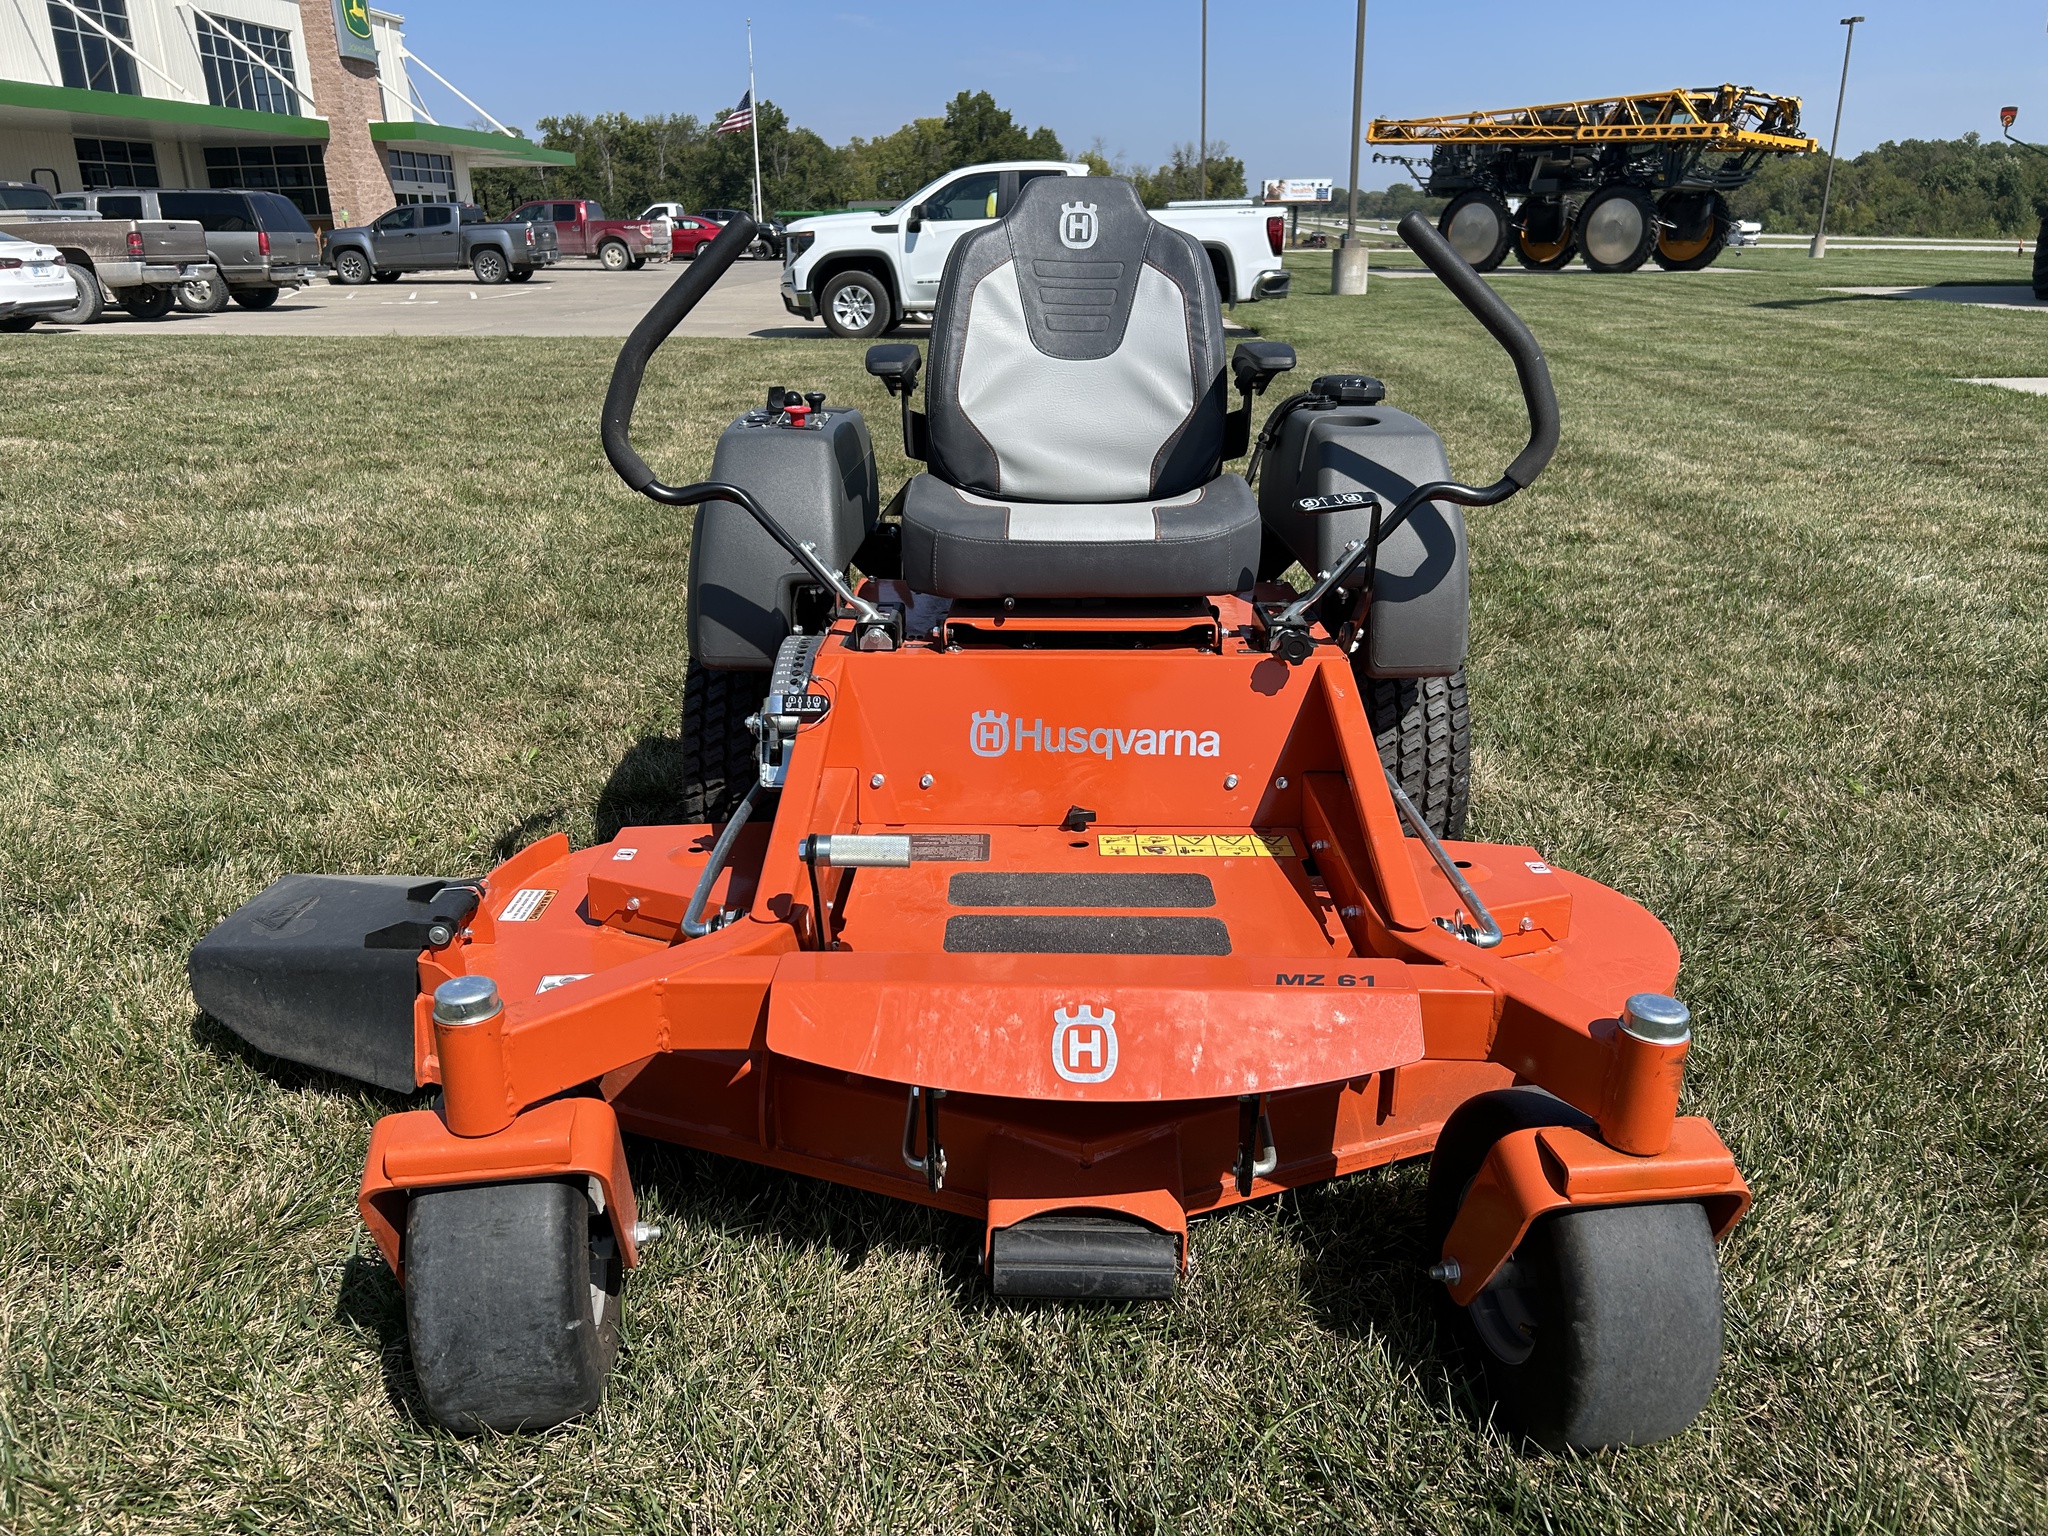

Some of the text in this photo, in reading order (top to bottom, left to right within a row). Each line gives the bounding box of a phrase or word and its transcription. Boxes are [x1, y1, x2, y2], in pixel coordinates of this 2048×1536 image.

[1069, 214, 1089, 240] H
[1014, 717, 1221, 761] Husqvarna
[1275, 973, 1375, 987] MZ 61
[1068, 1029, 1102, 1068] H
